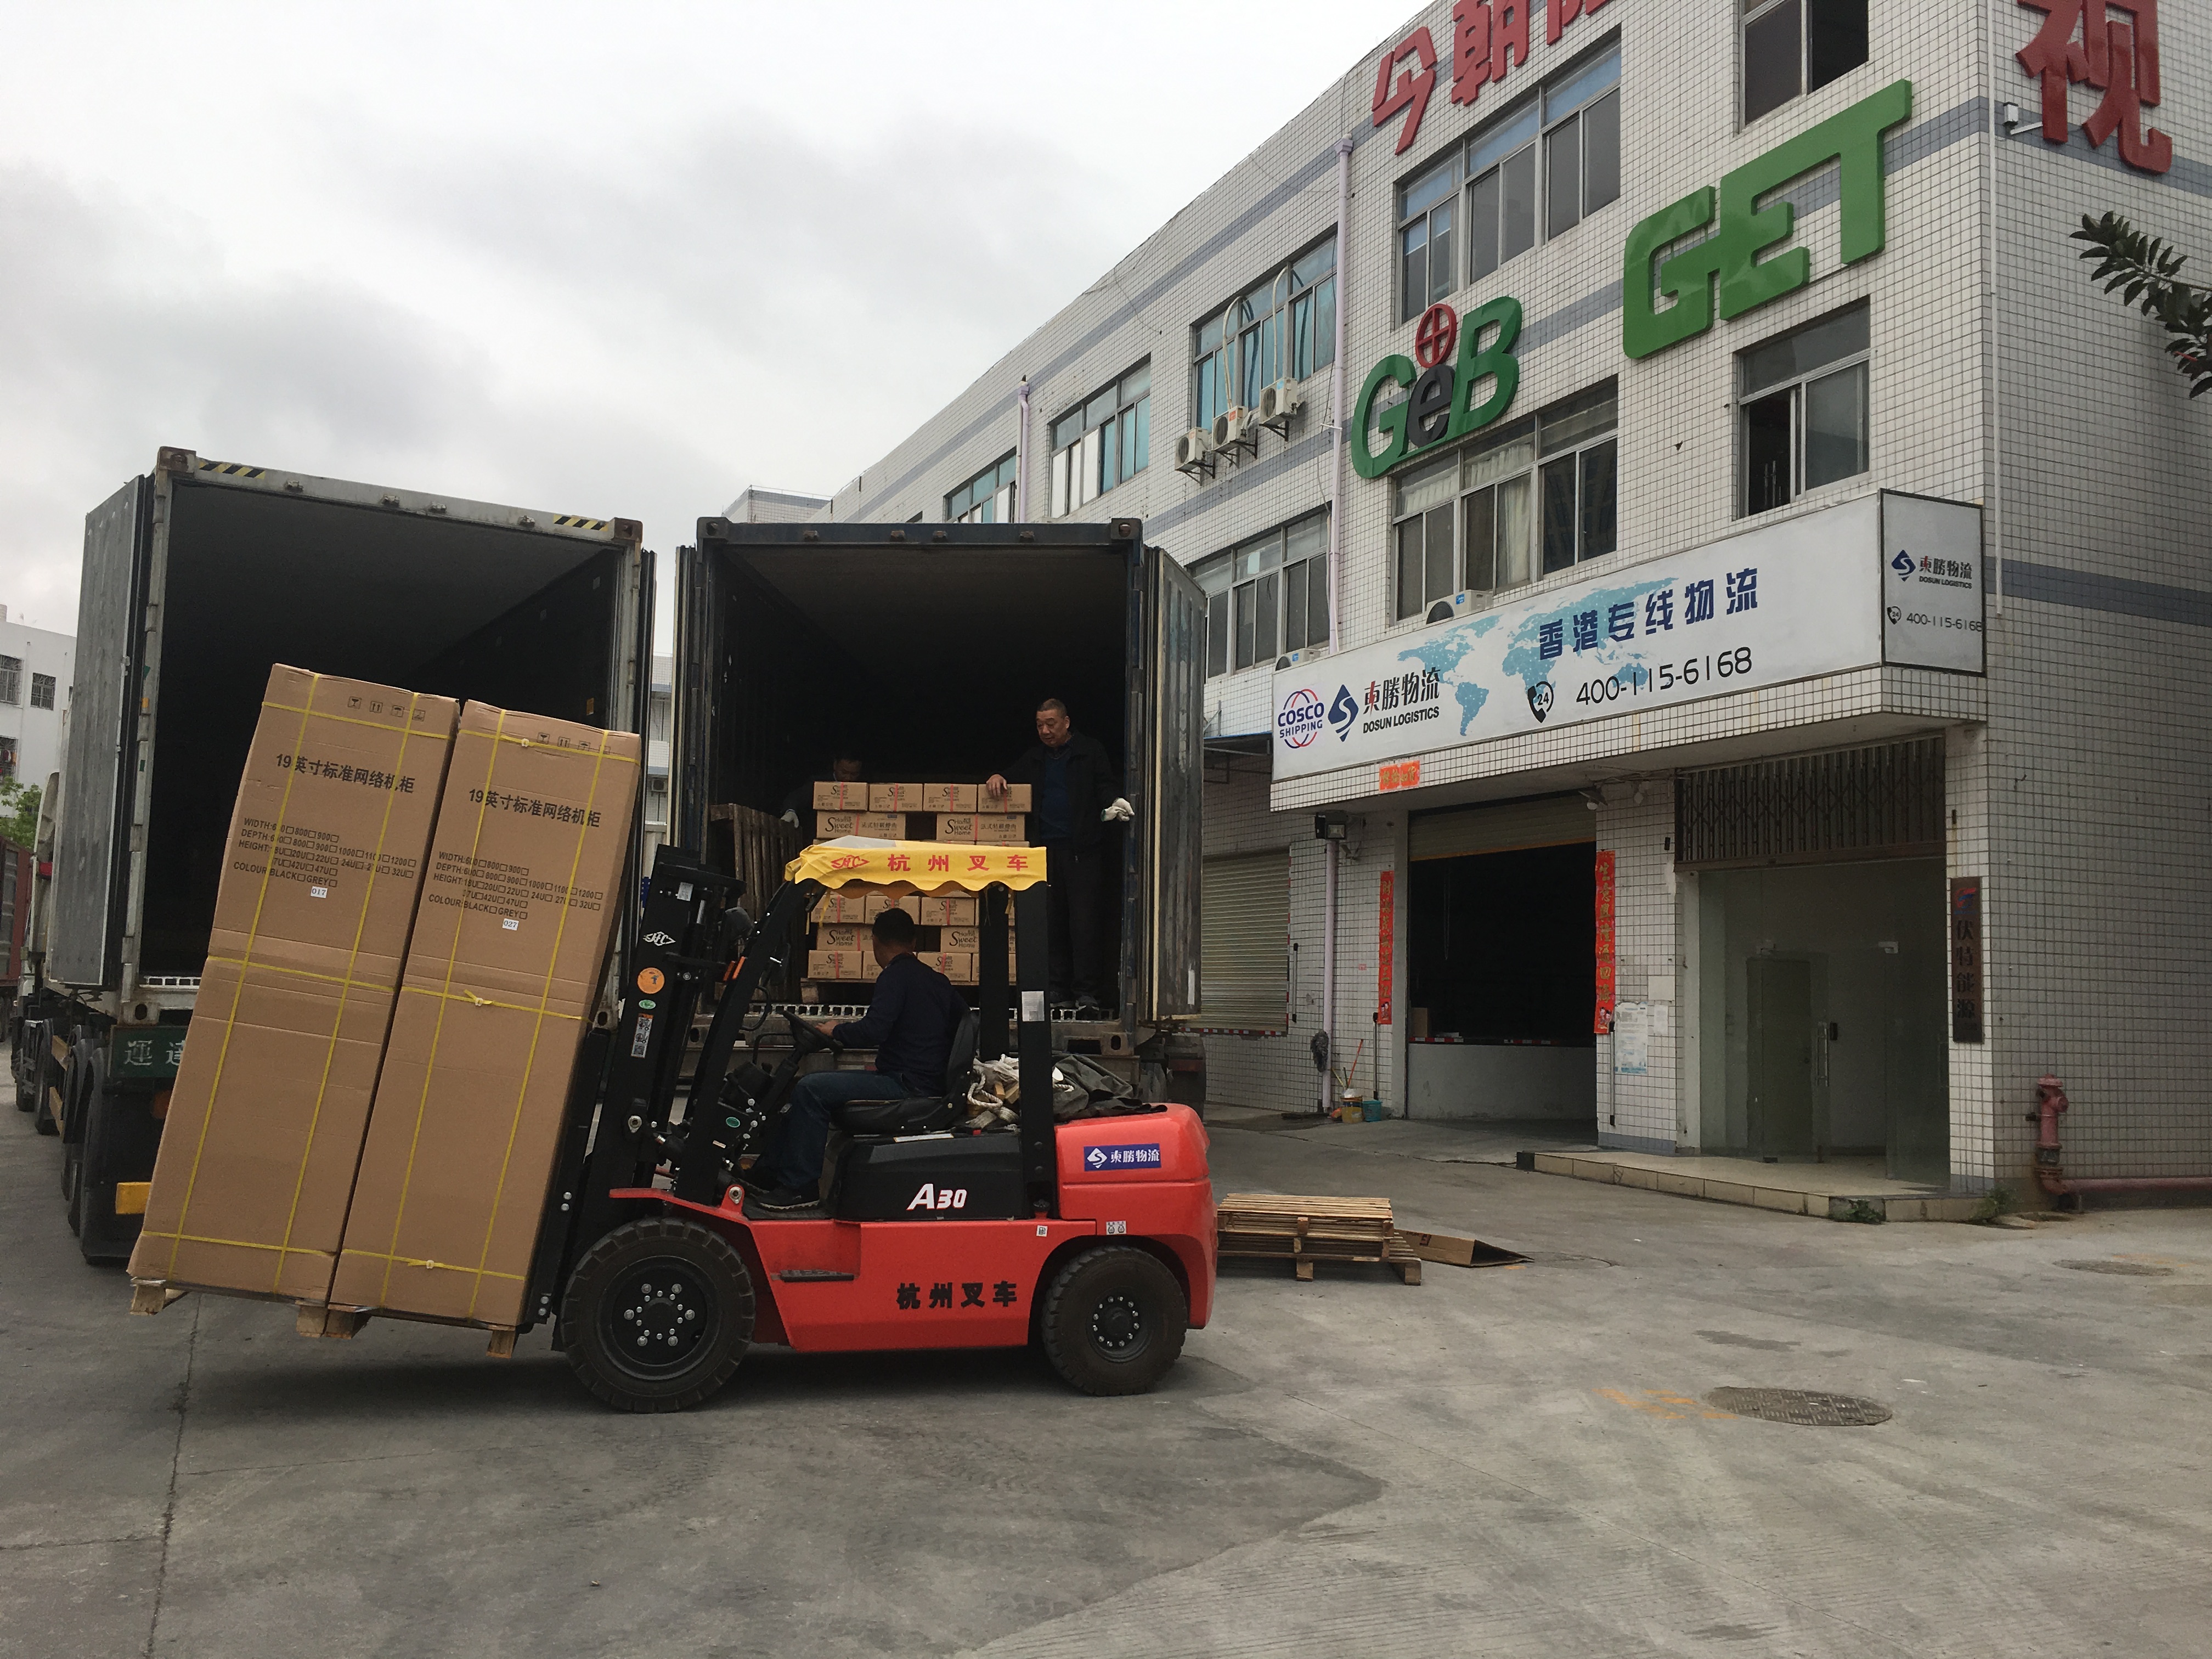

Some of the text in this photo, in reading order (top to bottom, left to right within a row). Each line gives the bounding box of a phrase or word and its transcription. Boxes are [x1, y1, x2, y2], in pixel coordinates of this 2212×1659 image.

[1623, 79, 1912, 360] GET
[1920, 556, 1972, 579] 東勝物流
[1919, 576, 1972, 589] DOSUN LOGISTICS
[1539, 568, 1757, 660] 香港专线物流
[1906, 613, 1982, 631] 400-115-6168
[1576, 647, 1752, 705] 400-115-6168
[1363, 667, 1441, 715] 東勝物流
[1537, 691, 1549, 706] 24
[1278, 702, 1324, 727] COSCO
[1363, 706, 1440, 734] DOSUN LOGISTICS
[1279, 719, 1323, 738] SHIPPING
[469, 788, 601, 827] 19英寸标准网络机柜
[244, 818, 285, 832] WIDTH:60
[241, 829, 284, 843] DEPTH:60
[888, 854, 1029, 872] 杭州叉车
[312, 888, 326, 896] 017
[504, 920, 517, 928] 027
[1110, 1148, 1160, 1164] 東勝物流
[907, 1183, 967, 1210] A30
[896, 1281, 1017, 1310] 杭州叉车
